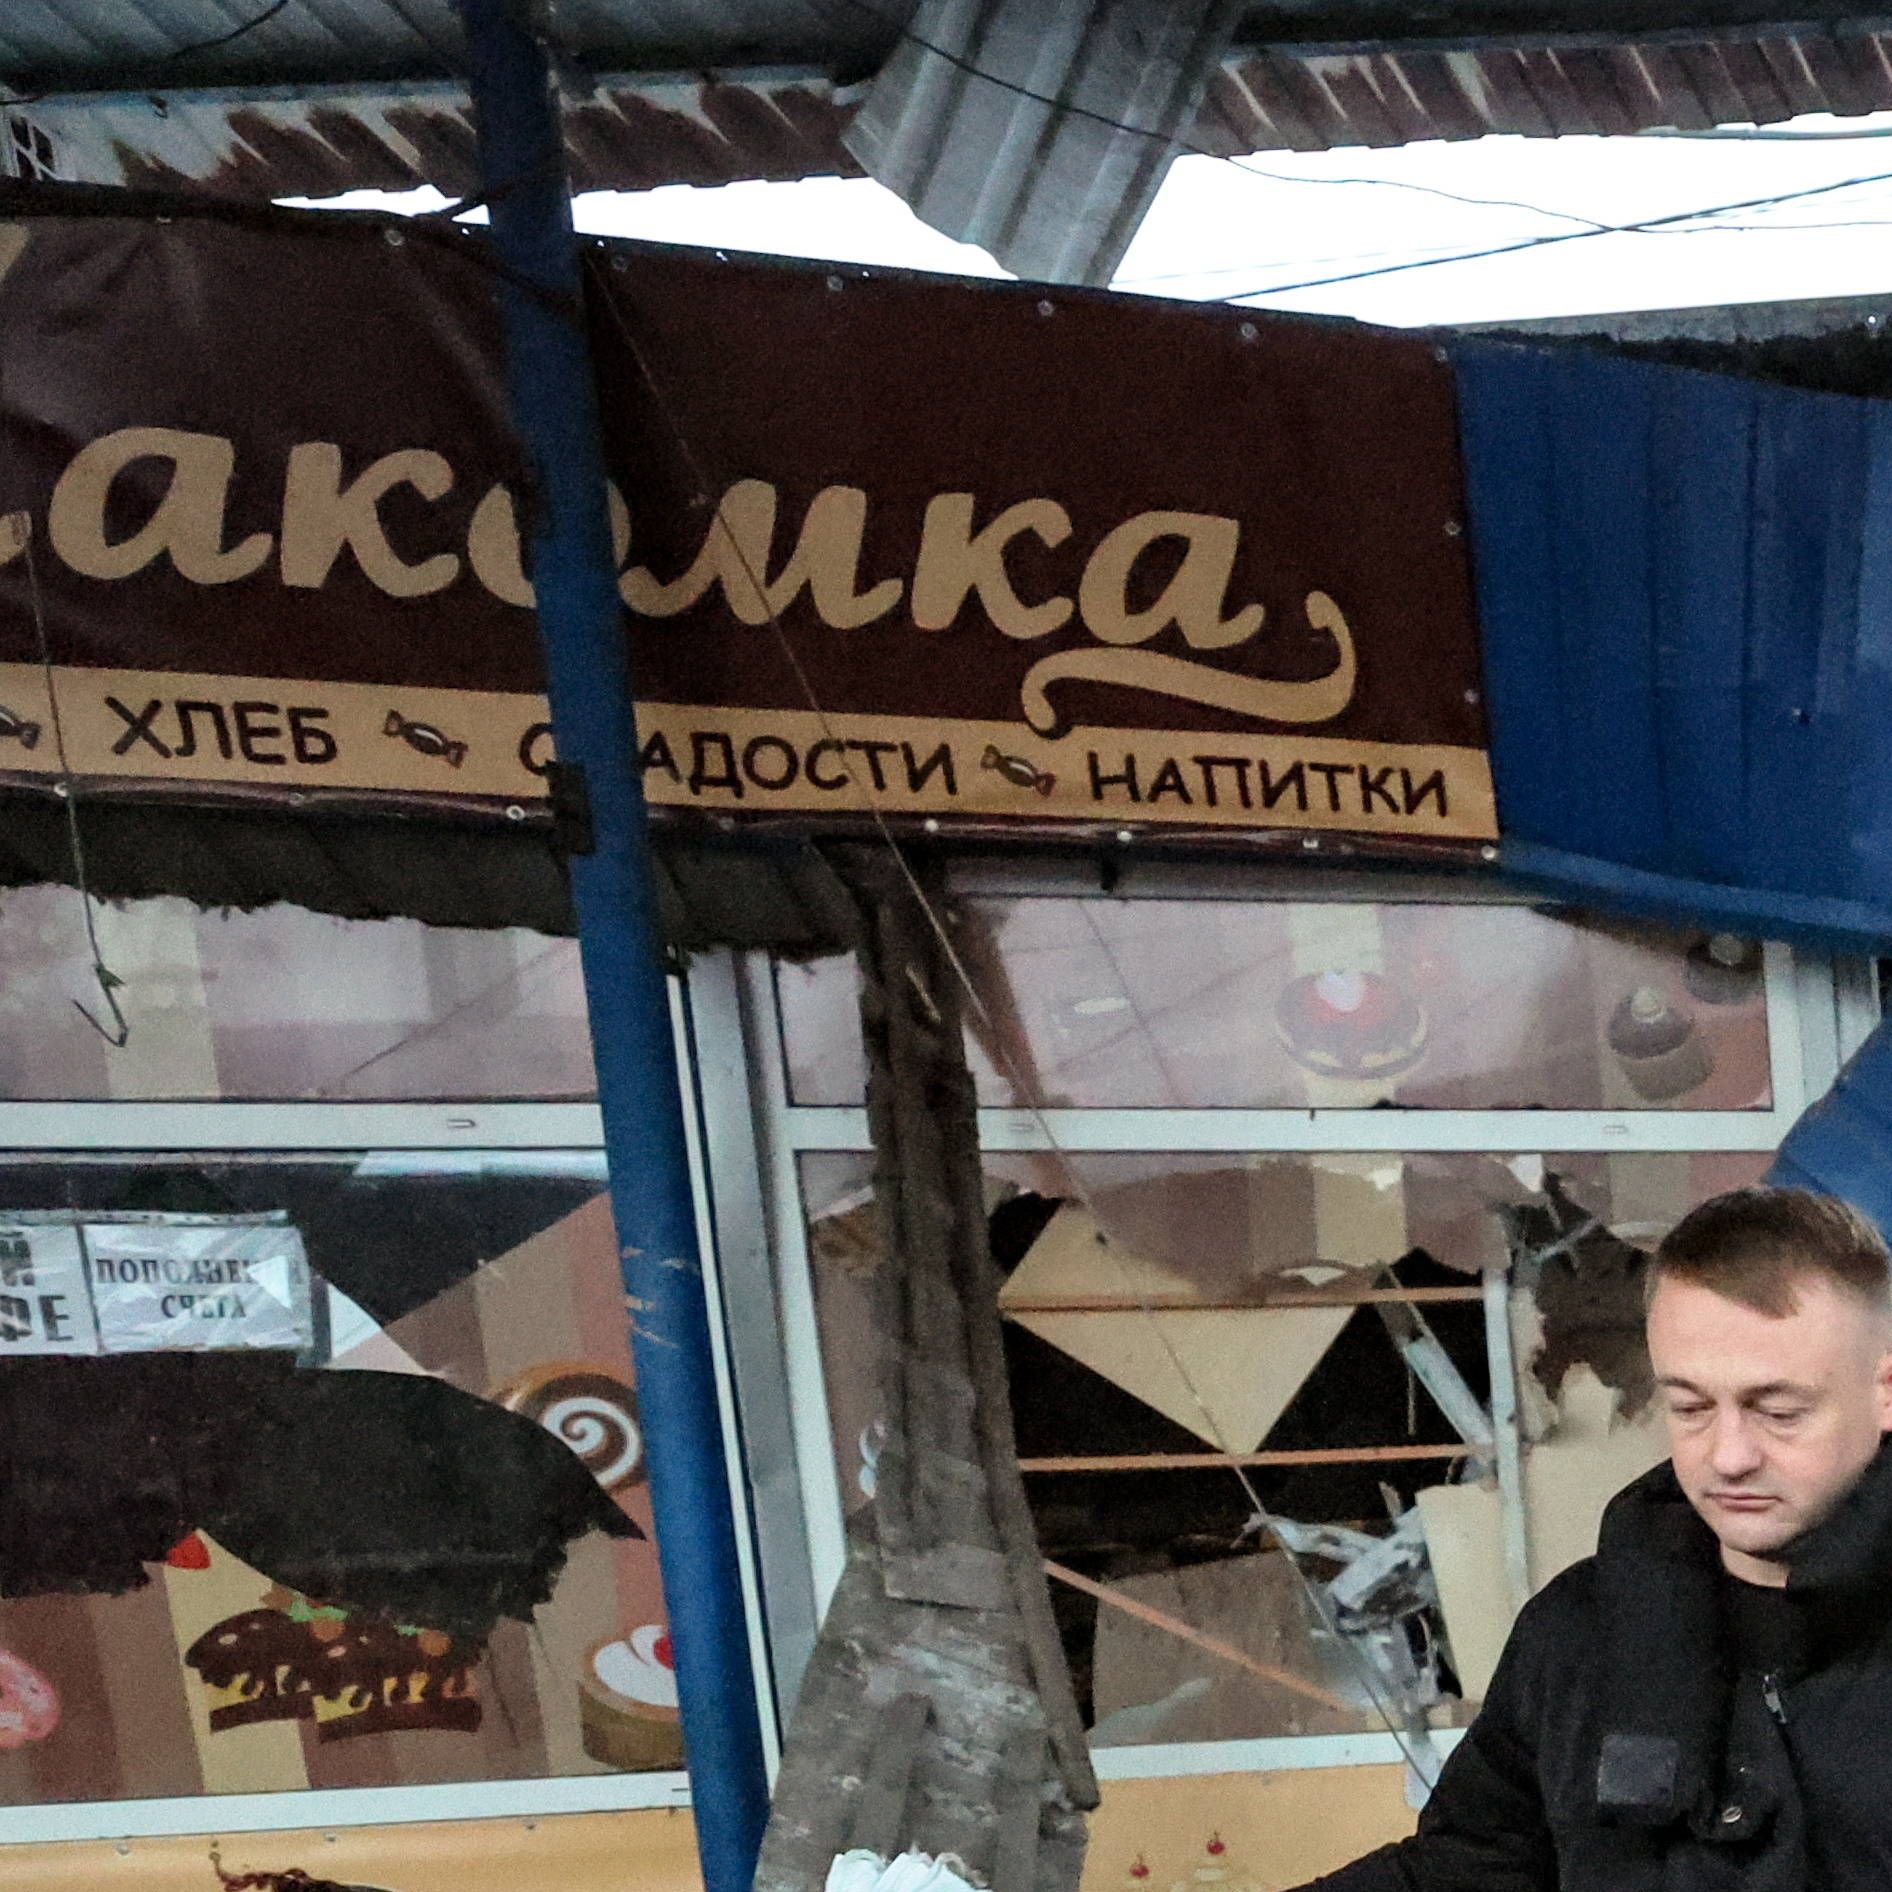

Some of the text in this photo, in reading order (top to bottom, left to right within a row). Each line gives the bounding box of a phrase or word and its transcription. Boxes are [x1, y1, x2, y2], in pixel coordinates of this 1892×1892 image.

[0, 425, 1265, 650] акомка
[105, 695, 1448, 818] ХЛЕБ САДОСТИ НАПИТКИ
